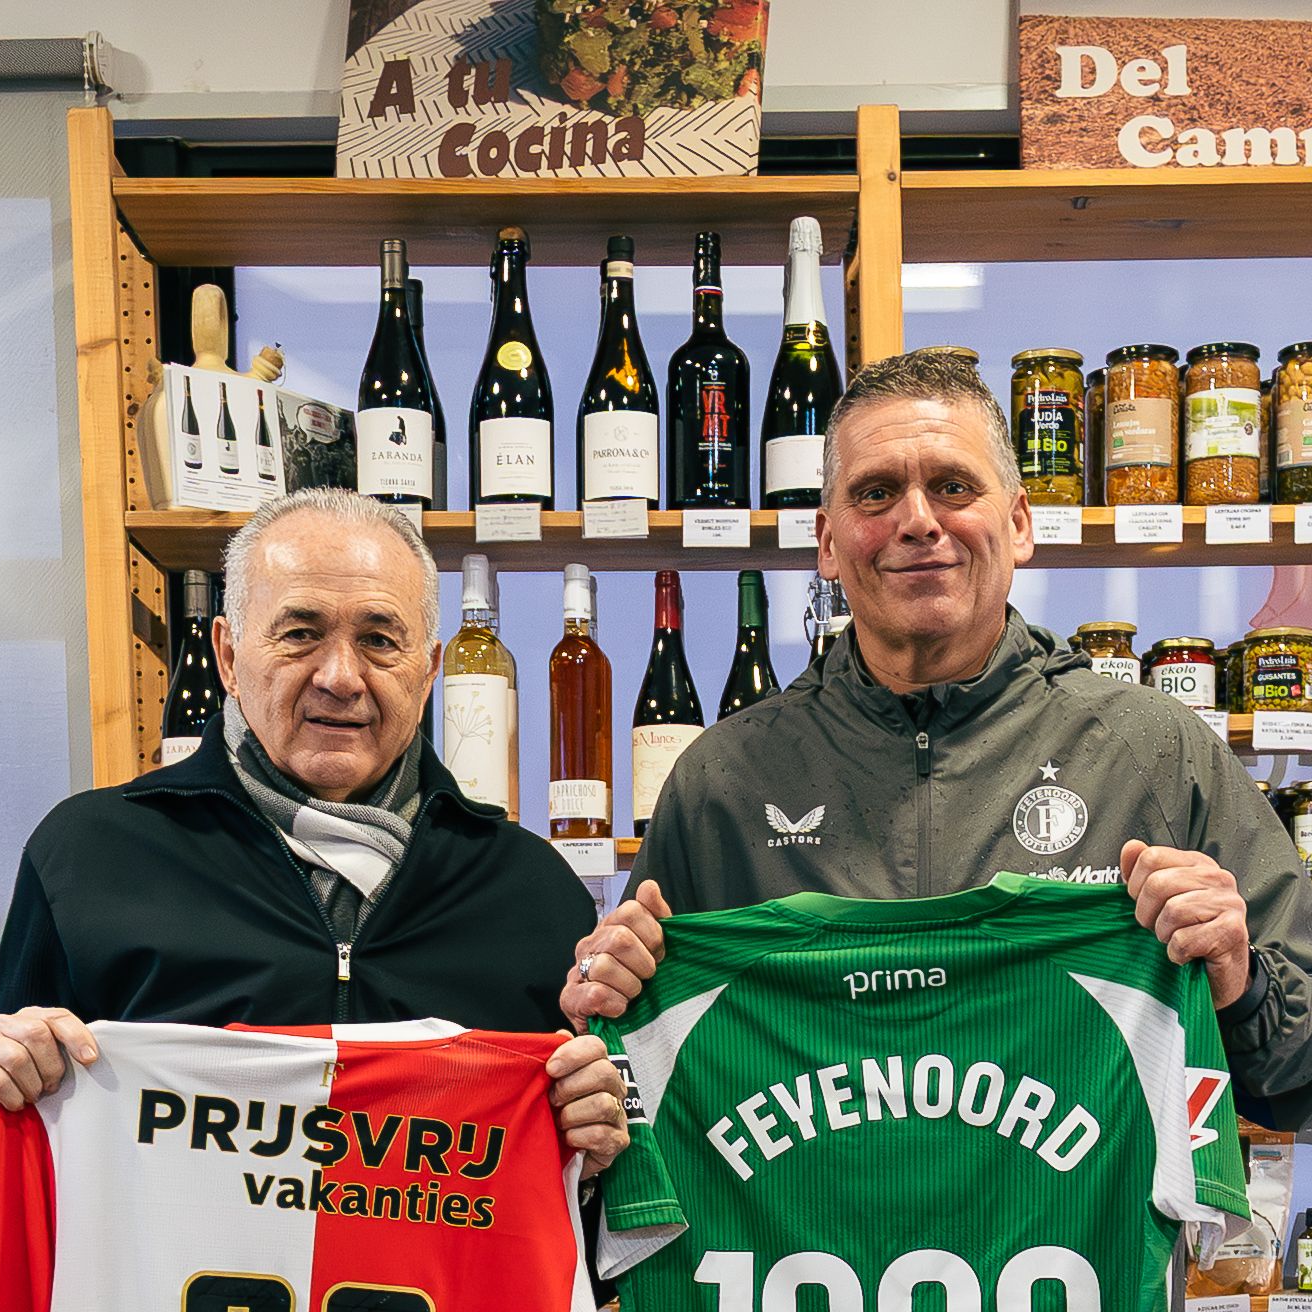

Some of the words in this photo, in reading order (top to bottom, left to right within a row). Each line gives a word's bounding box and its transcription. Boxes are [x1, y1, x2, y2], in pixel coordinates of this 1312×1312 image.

[1054, 43, 1191, 99] Del
[368, 59, 417, 118] A
[445, 57, 511, 107] tu
[437, 114, 648, 177] Cocina
[1160, 664, 1197, 676] ekolo
[1160, 676, 1197, 694] BIO
[1257, 671, 1297, 681] GUISANTES
[1018, 788, 1081, 813] FEYENOORD
[1035, 805, 1065, 838] F
[766, 835, 822, 848] CASTORE
[1018, 825, 1082, 852] ROTTERDAM
[1067, 866, 1121, 884] Markt
[842, 966, 948, 1000] prima
[705, 1053, 1101, 1182] FEYENOORD
[242, 1170, 496, 1230] vakanties
